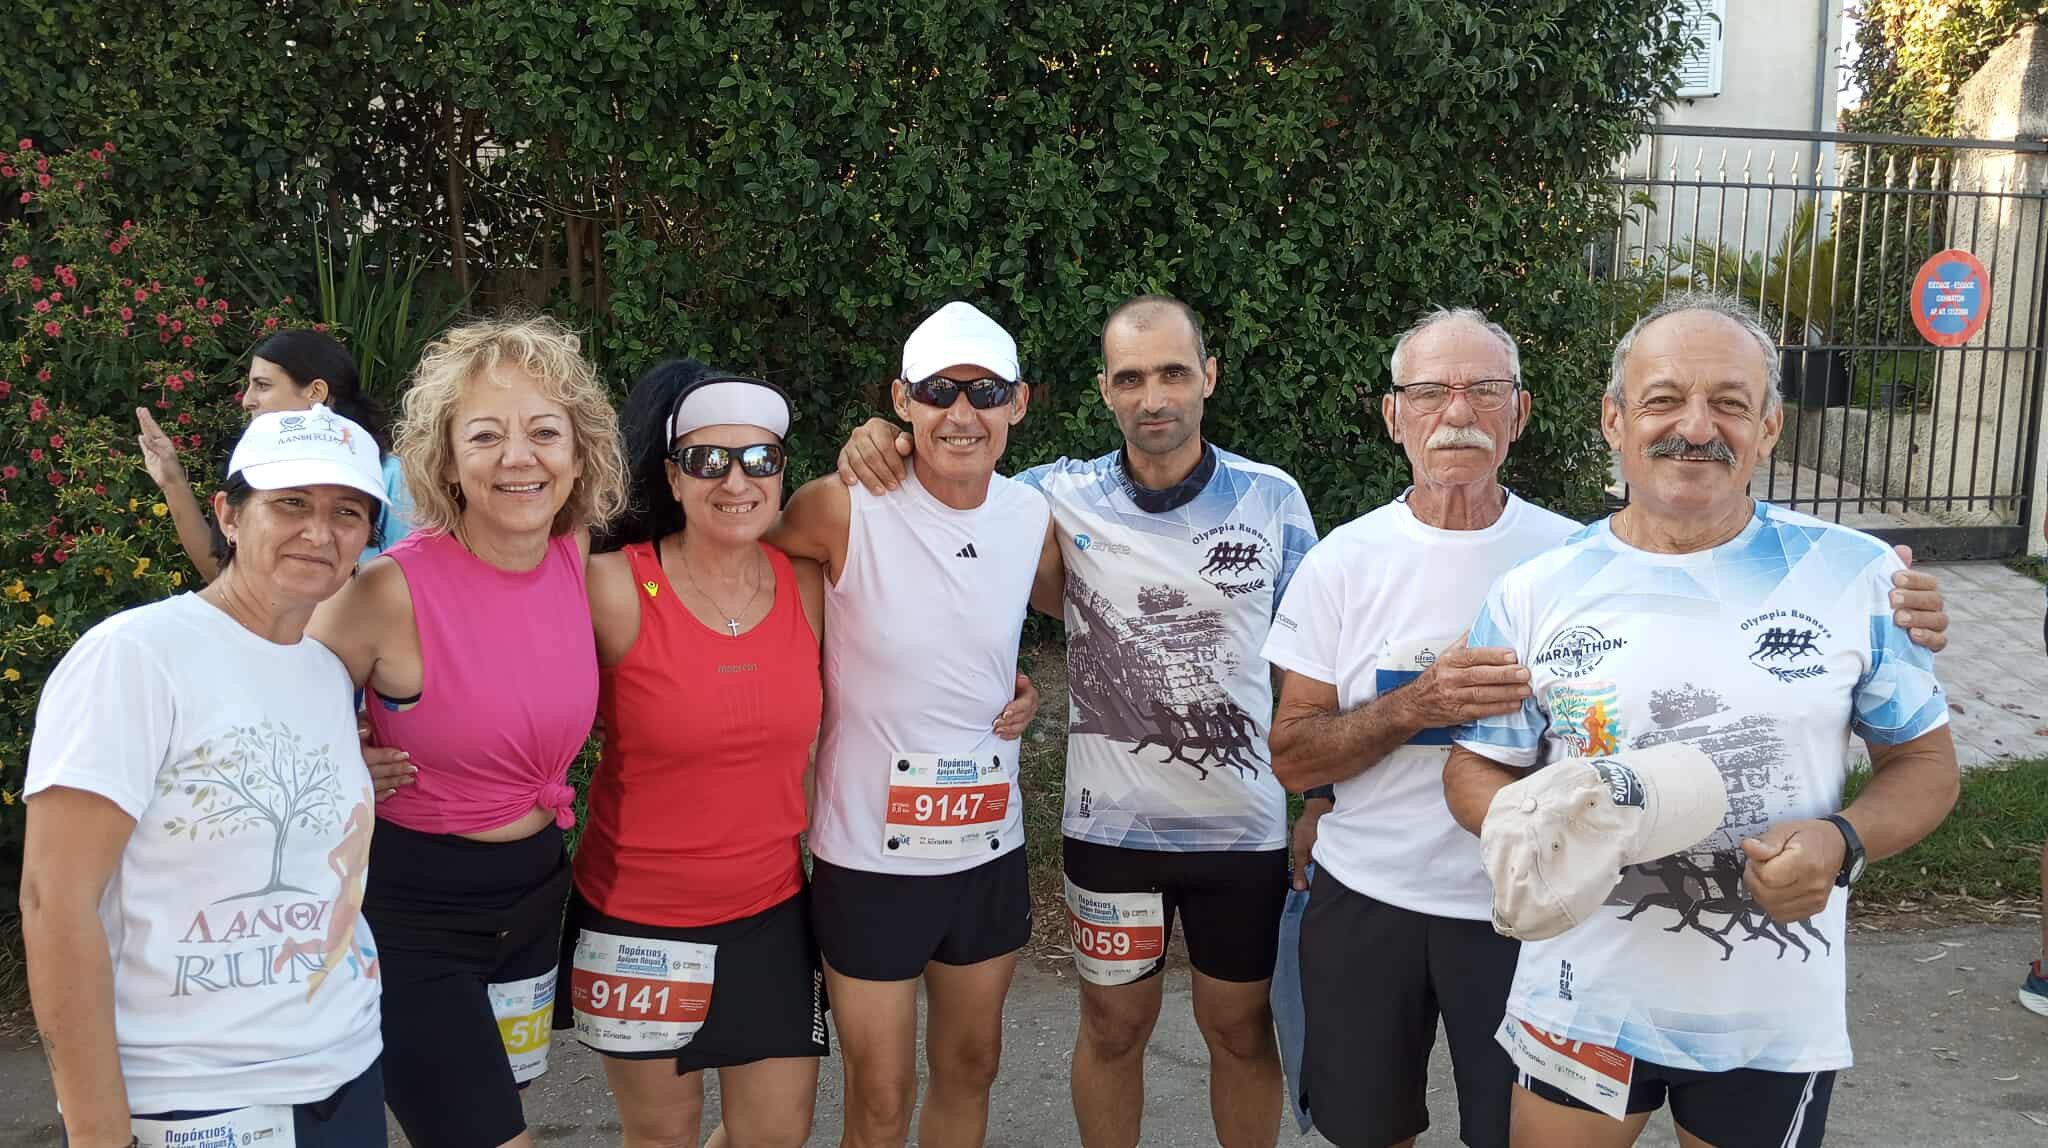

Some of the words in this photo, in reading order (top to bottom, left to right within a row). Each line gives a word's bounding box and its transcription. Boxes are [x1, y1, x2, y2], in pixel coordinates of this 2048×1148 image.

[1192, 522, 1235, 545] Olympia
[1239, 522, 1273, 553] Runners
[1740, 608, 1787, 631] Olympia
[1791, 608, 1832, 639] Runners
[1536, 637, 1623, 666] MARATHON
[914, 793, 985, 821] 9147
[178, 900, 329, 943] ΛΑΝΘΙ
[1073, 920, 1130, 955] 9059
[169, 944, 328, 998] RUN
[591, 980, 671, 1015] 9141
[812, 969, 825, 1045] RUNNING
[165, 1126, 226, 1144] Παράκτιος
